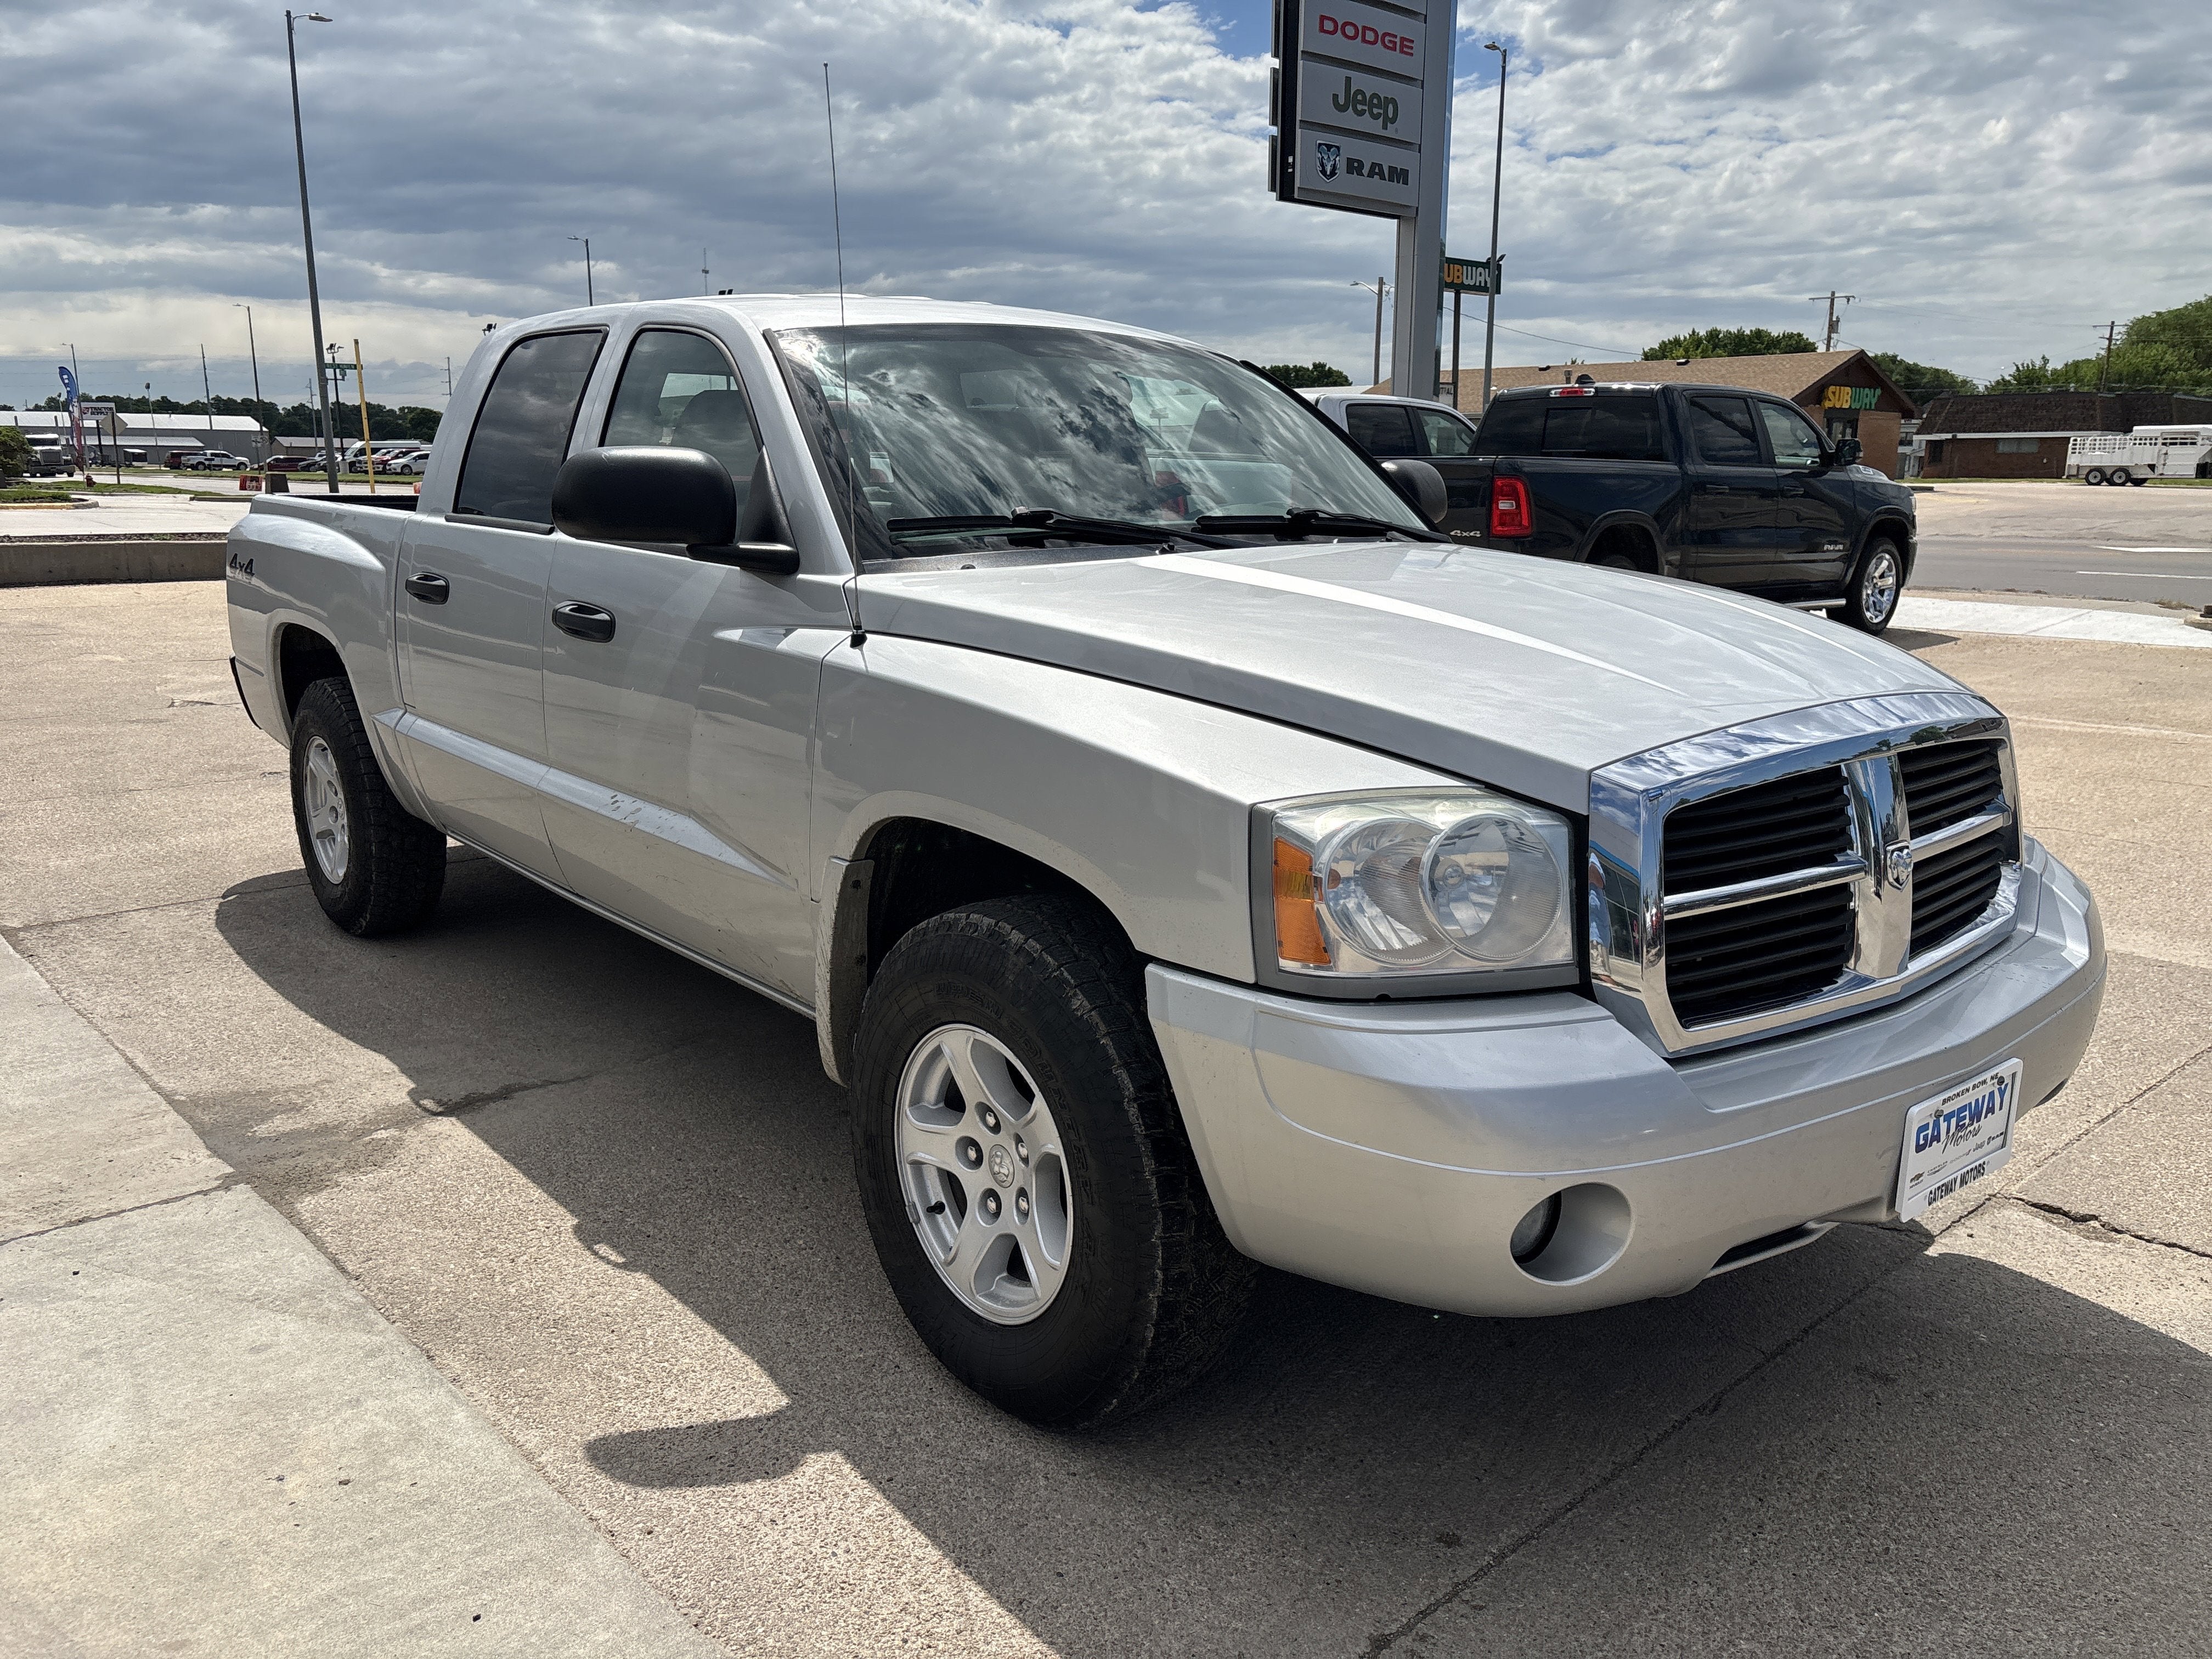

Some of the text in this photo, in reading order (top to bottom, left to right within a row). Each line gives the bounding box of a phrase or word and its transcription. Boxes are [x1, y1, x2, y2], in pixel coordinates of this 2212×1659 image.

[1318, 14, 1414, 57] DODGE
[1332, 76, 1398, 130] Jeep
[1346, 157, 1409, 185] RAM
[1444, 263, 1498, 287] UBWAY
[1824, 386, 1882, 409] SUBWAY
[229, 553, 255, 576] 4x4
[1942, 1073, 1999, 1106] BROKEN BOW, NE
[1915, 1082, 2009, 1154] GATEWAY
[1942, 1121, 1983, 1154] Motors
[1928, 1160, 1986, 1206] GATEWAY MOTORS
